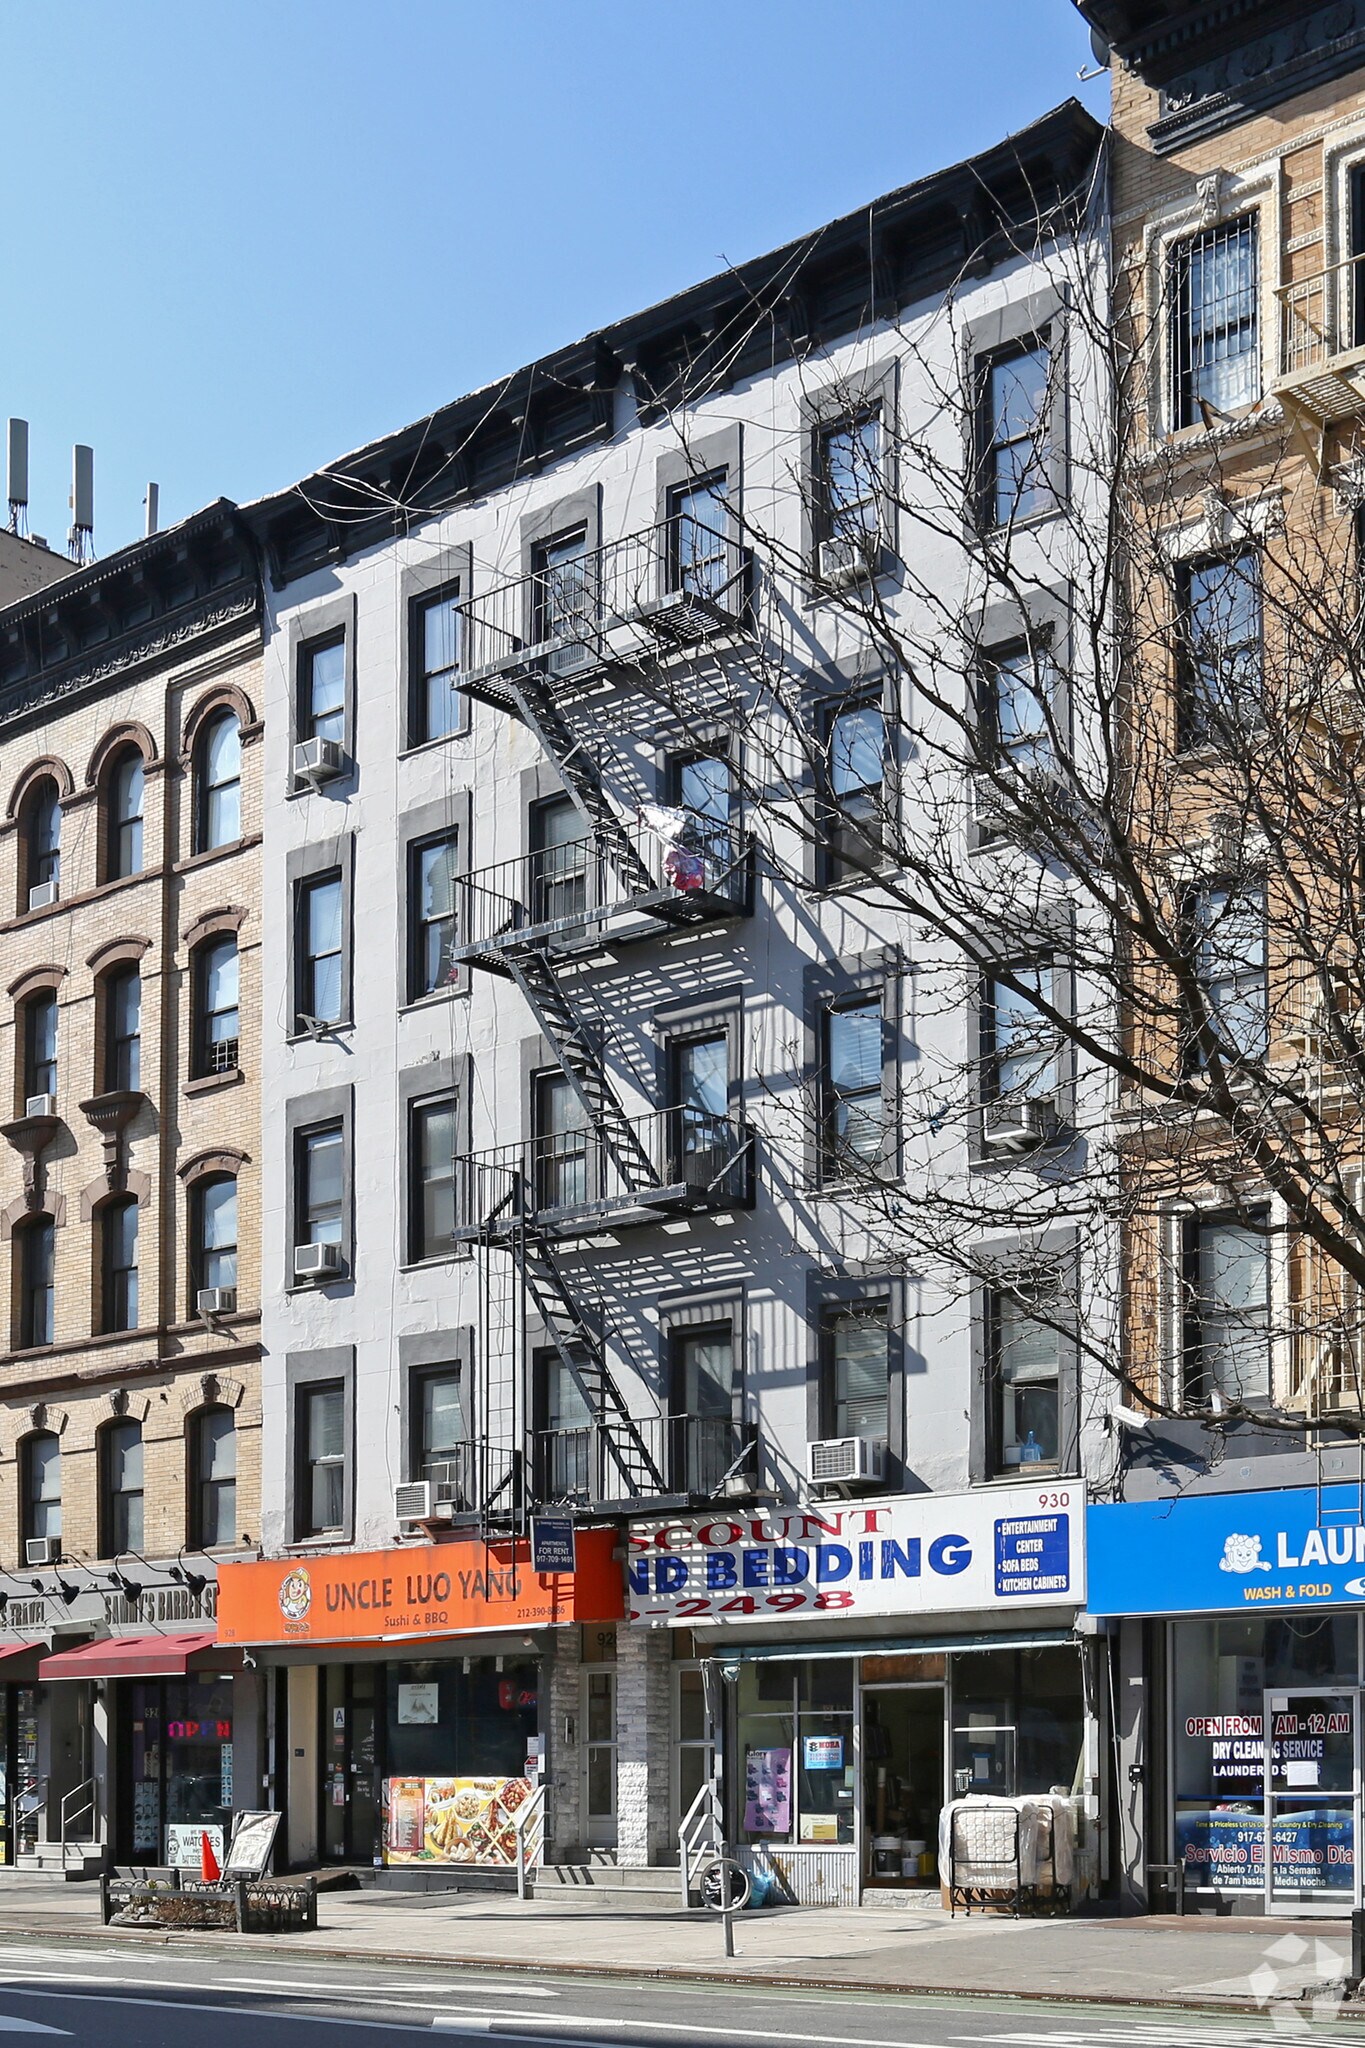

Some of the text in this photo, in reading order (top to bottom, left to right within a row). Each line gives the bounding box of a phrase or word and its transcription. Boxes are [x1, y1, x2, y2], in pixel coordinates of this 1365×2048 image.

[1039, 1492, 1070, 1509] 930
[628, 1507, 892, 1553] SCOUNT
[1001, 1519, 1058, 1536] ENTERTAINMENT
[538, 1547, 569, 1555] FOR RENT
[1016, 1538, 1044, 1554] CENTER
[629, 1532, 973, 1595] ND BEDDING
[1002, 1558, 1039, 1573] SOFA BEDS
[325, 1566, 522, 1612] UNCLE LUO YANG
[1002, 1575, 1067, 1592] KITCHEN CABINETS
[1243, 1583, 1333, 1600] WASH & FOLD
[384, 1611, 448, 1627] Sushi & BBQ
[517, 1604, 566, 1618] 212-390-886
[597, 1632, 617, 1646] 92
[336, 1711, 343, 1722] A
[1186, 1717, 1222, 1736] OPEN
[1224, 1715, 1262, 1736] FROM
[1275, 1714, 1297, 1735] AM
[1307, 1713, 1325, 1734] 12
[1327, 1712, 1350, 1734] AM
[1213, 1740, 1323, 1760] DRY CLEANG SERVICE
[1213, 1765, 1279, 1776] LAUNDERD
[1279, 1821, 1301, 1829] Laundry
[183, 1836, 221, 1848] WATCES
[1237, 1831, 1297, 1843] 917-67-6427
[1185, 1843, 1355, 1865] Servicio El Mismo Dia
[1217, 1864, 1321, 1875] Abierto 7 Dia a la Semana
[1213, 1875, 1326, 1887] de 7am hasta Media Noche
